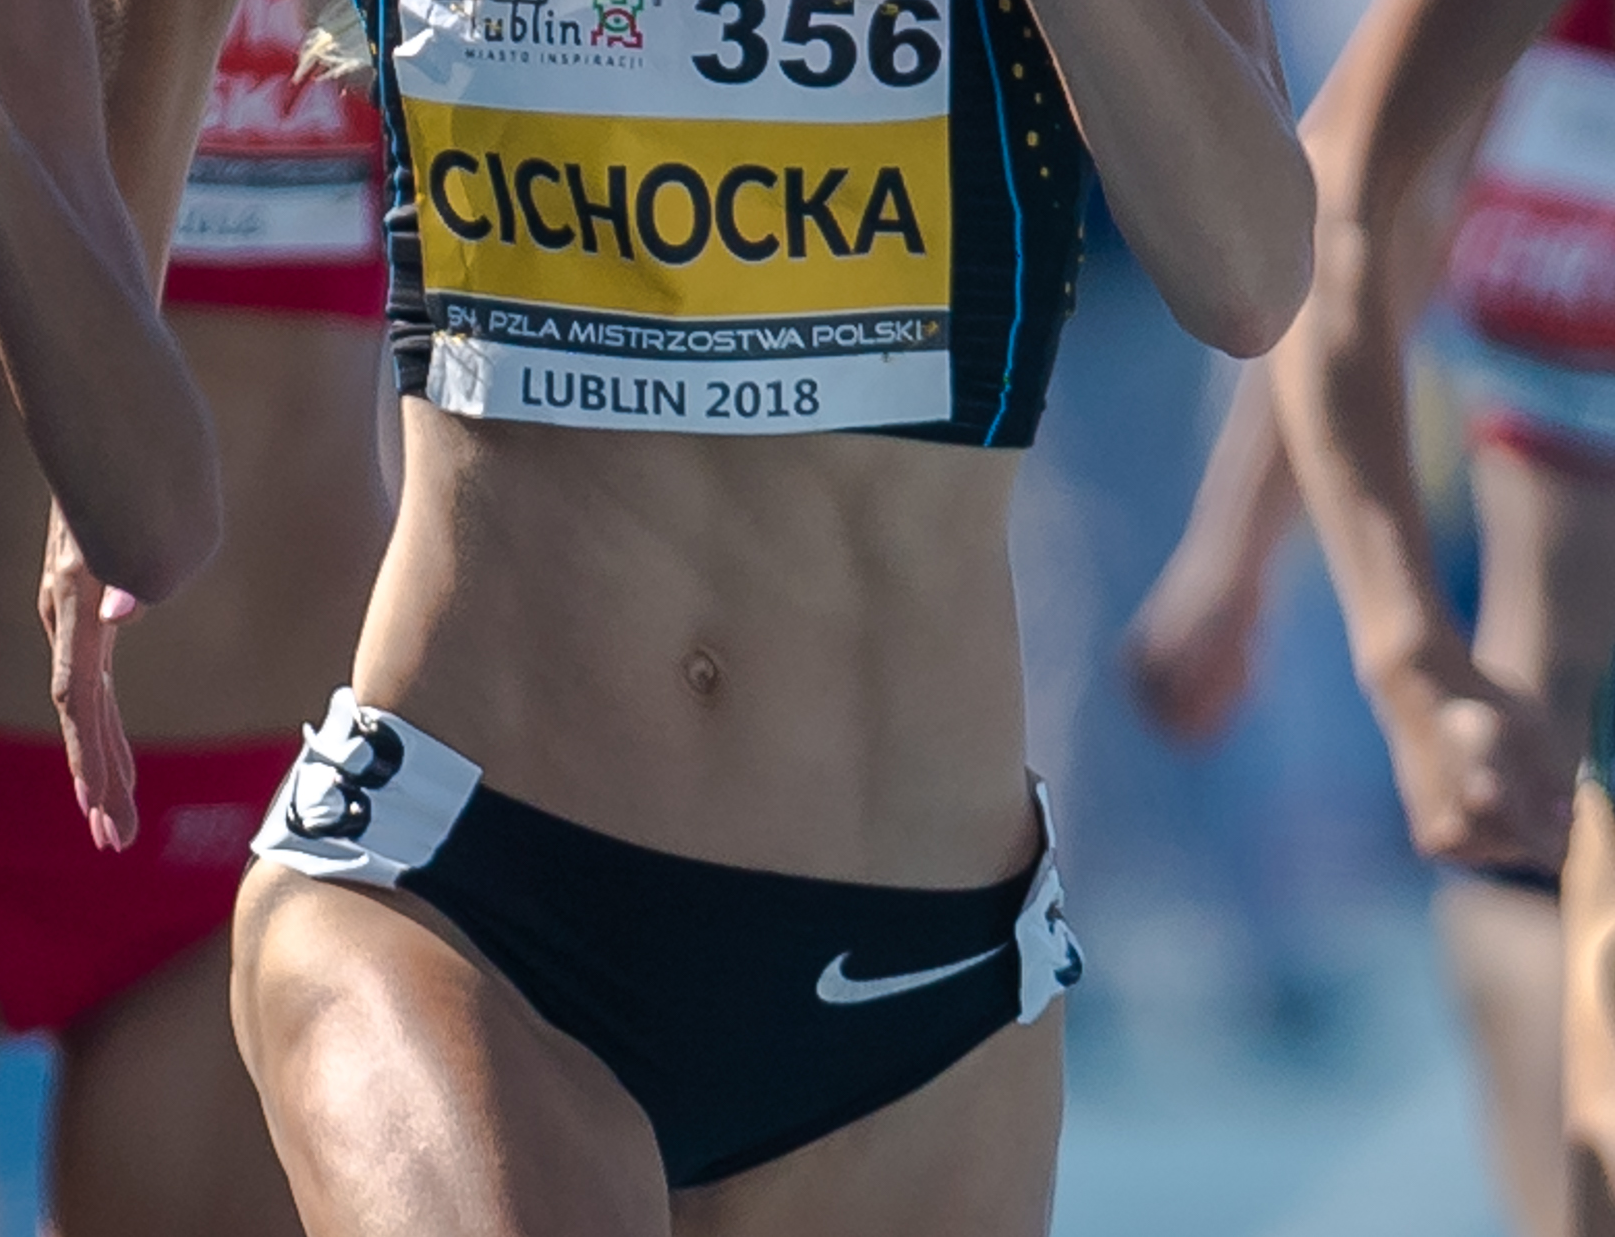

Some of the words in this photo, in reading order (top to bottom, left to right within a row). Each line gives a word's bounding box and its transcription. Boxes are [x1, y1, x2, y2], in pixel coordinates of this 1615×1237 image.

[464, 49, 530, 64] MIASTO
[540, 51, 644, 69] INSPIRACJI
[428, 149, 926, 265] CICHOCKA
[489, 314, 561, 341] PZLA
[568, 321, 805, 352] MISTRZOSTWA
[812, 320, 922, 348] POLSKI
[522, 367, 687, 416] LUBLIN
[706, 379, 820, 418] 2018
